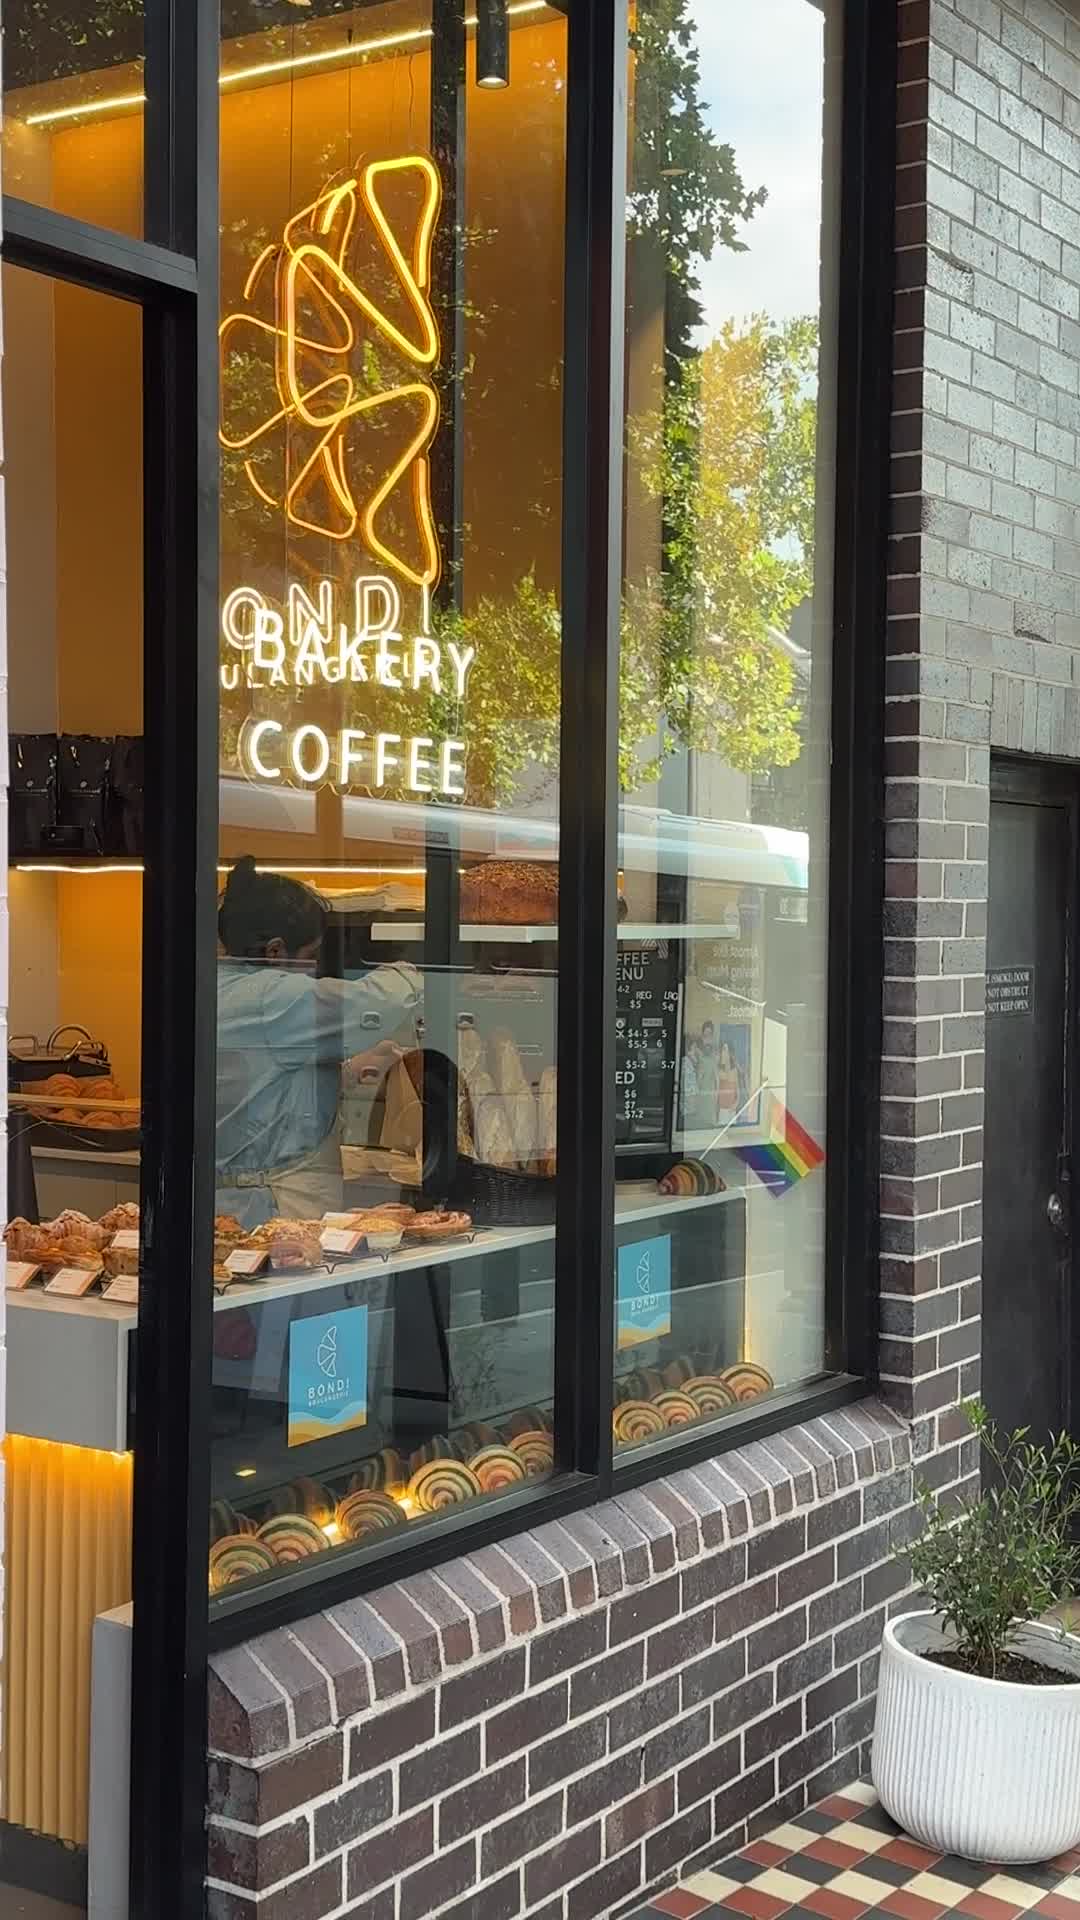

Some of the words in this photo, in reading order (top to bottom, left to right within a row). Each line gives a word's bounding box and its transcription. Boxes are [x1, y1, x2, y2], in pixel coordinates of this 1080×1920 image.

[253, 608, 475, 697] BAKERY
[250, 719, 465, 795] COFFEE
[635, 990, 652, 1000] REG
[630, 999, 642, 1009] $5
[661, 1029, 668, 1038] 5
[627, 1039, 648, 1049] $5.5
[656, 1039, 663, 1048] 6
[625, 1059, 647, 1070] $5.2
[624, 1088, 637, 1099] $6
[624, 1100, 636, 1110] $7
